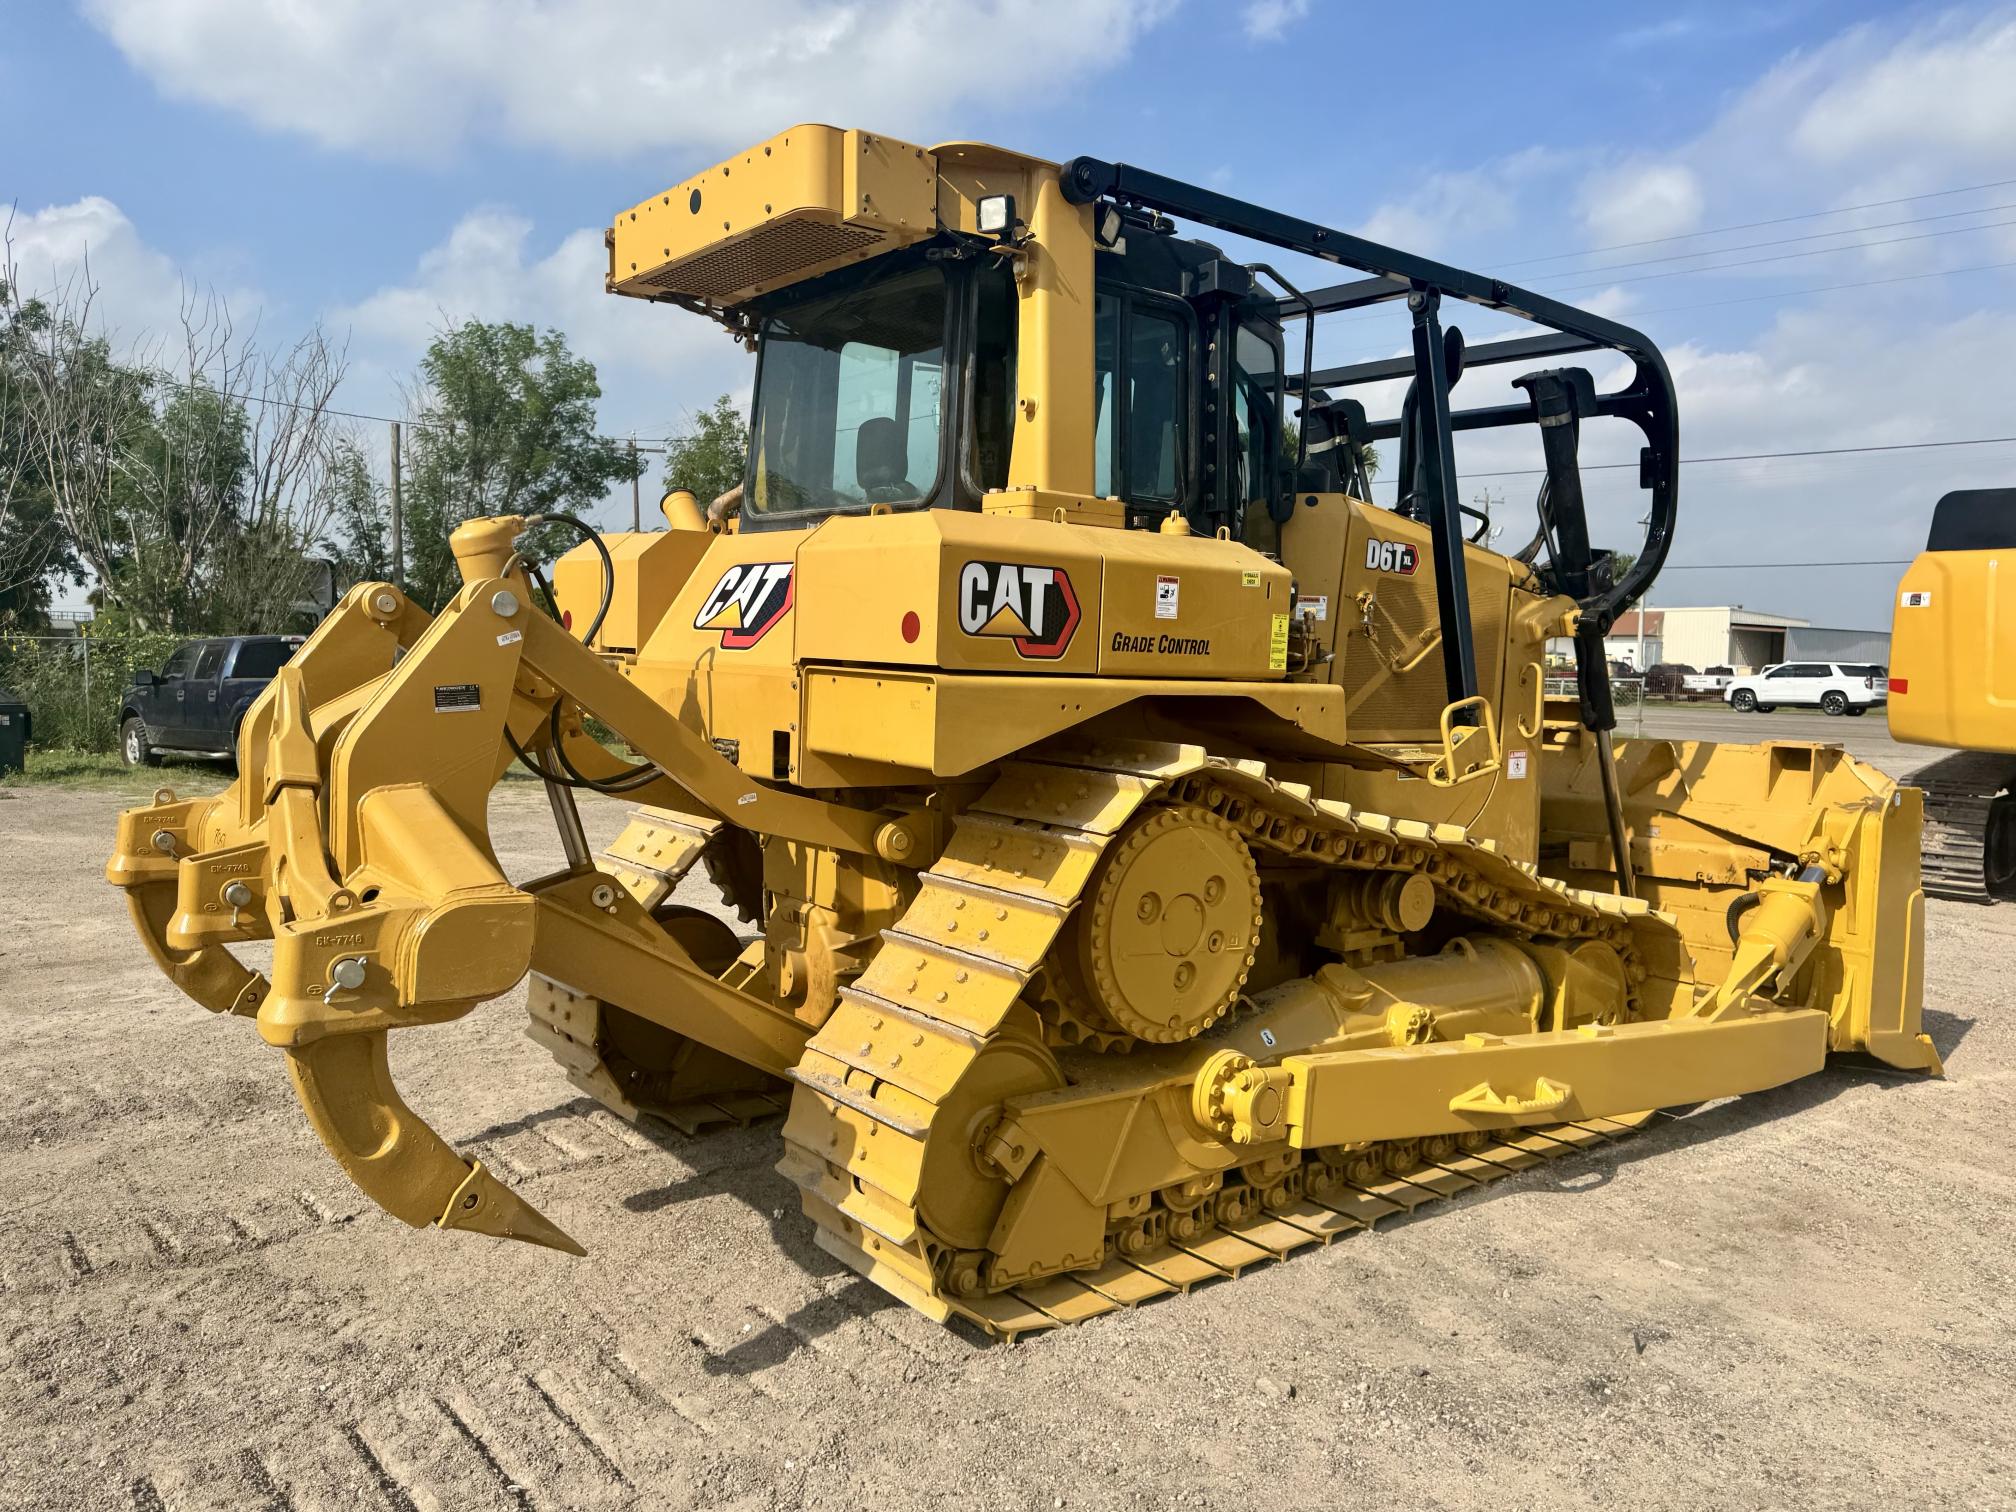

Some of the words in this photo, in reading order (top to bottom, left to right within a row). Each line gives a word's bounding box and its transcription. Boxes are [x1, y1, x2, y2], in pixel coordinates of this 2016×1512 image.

[1366, 538, 1407, 572] D6T
[695, 564, 794, 629] CAT
[961, 562, 1054, 637] CAT
[1112, 632, 1155, 653] GRADE
[1158, 634, 1211, 655] CONTROL
